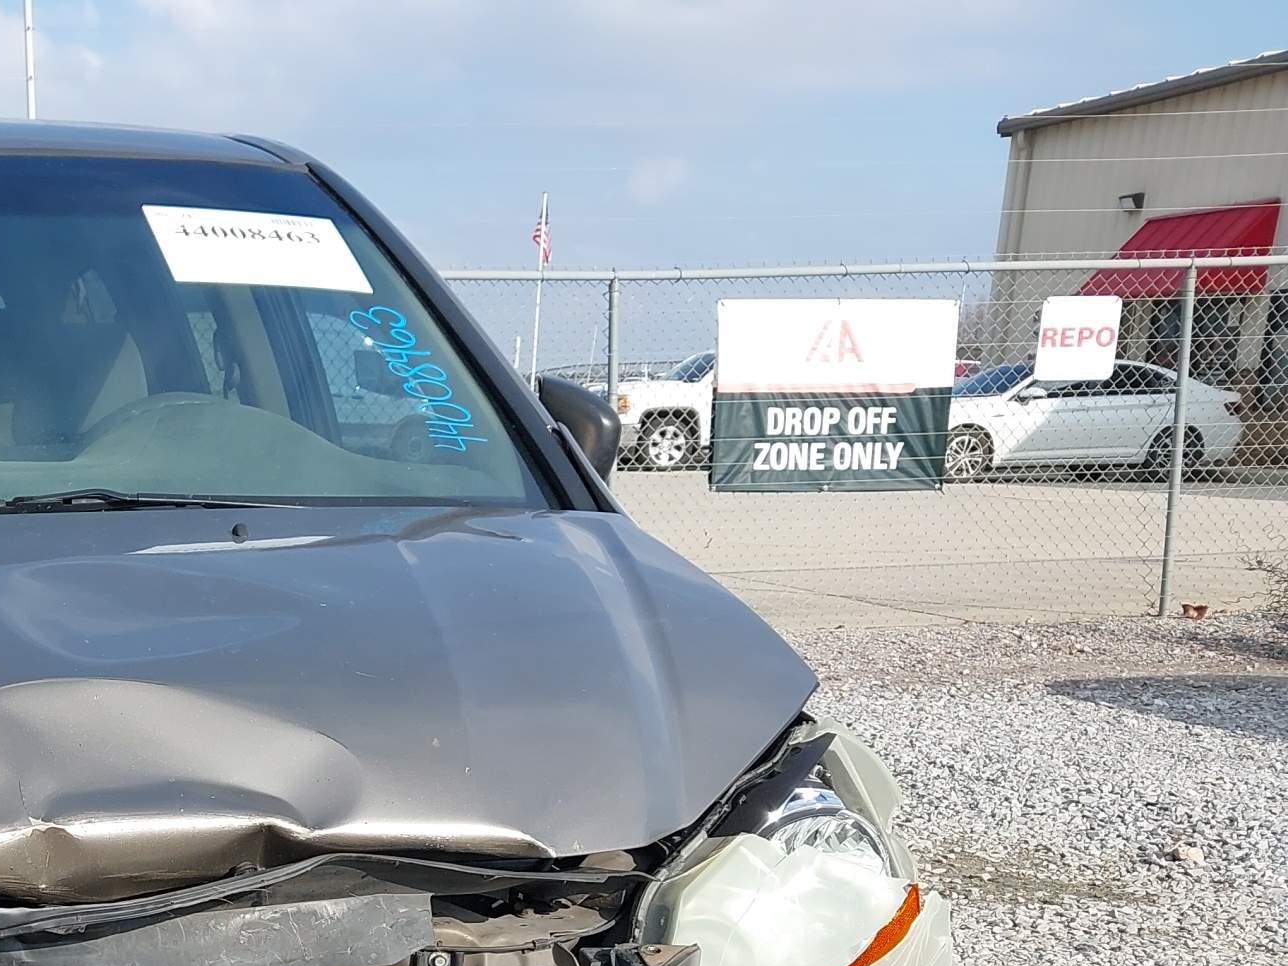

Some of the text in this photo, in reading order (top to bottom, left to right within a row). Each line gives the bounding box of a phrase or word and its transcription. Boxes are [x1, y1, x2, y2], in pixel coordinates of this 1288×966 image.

[176, 224, 320, 244] 44008463
[1040, 326, 1116, 348] REPO
[350, 306, 488, 451] 44008463
[767, 406, 897, 436] DROP OFF
[752, 441, 905, 471] ZONE ONLY
